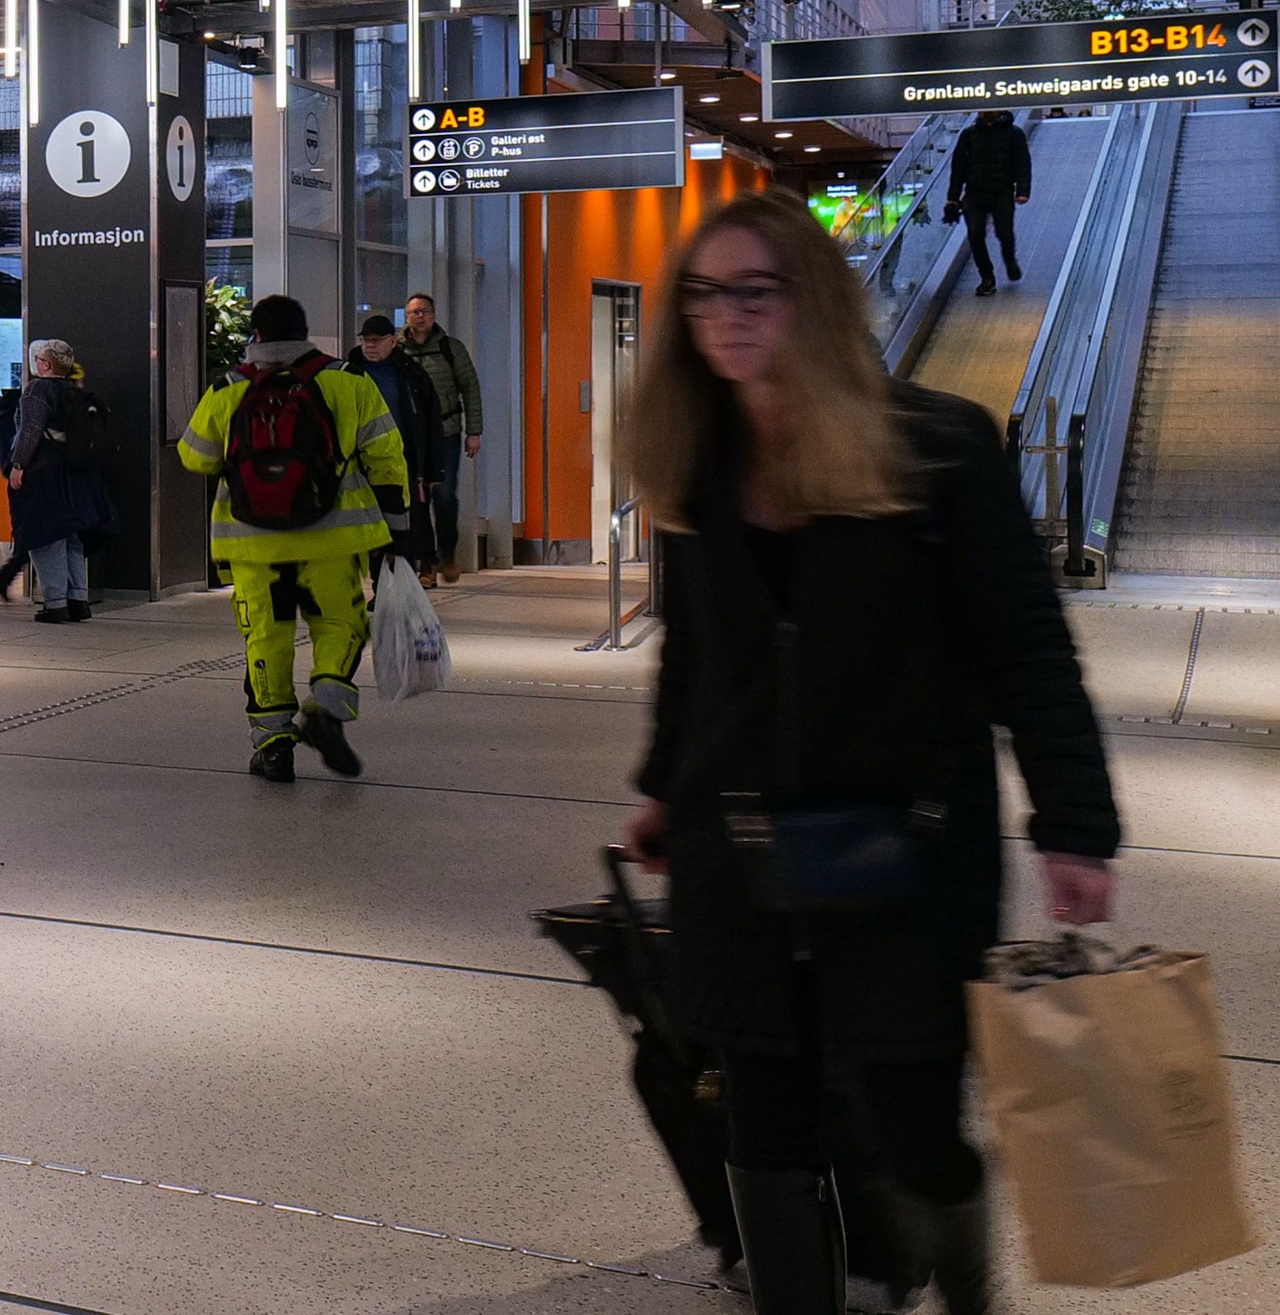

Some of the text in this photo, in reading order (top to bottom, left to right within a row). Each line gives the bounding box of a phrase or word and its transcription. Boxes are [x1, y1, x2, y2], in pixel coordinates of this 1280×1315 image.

[1090, 24, 1227, 56] B13-B14
[904, 68, 1228, 102] Grønland, Schweigaards gate 10-14
[440, 107, 486, 129] A-B
[491, 133, 545, 145] Galleri øst
[491, 146, 522, 156] P-hus
[466, 167, 509, 179] Billetter
[466, 179, 500, 190] Tickets
[34, 226, 145, 247] Informasjon
